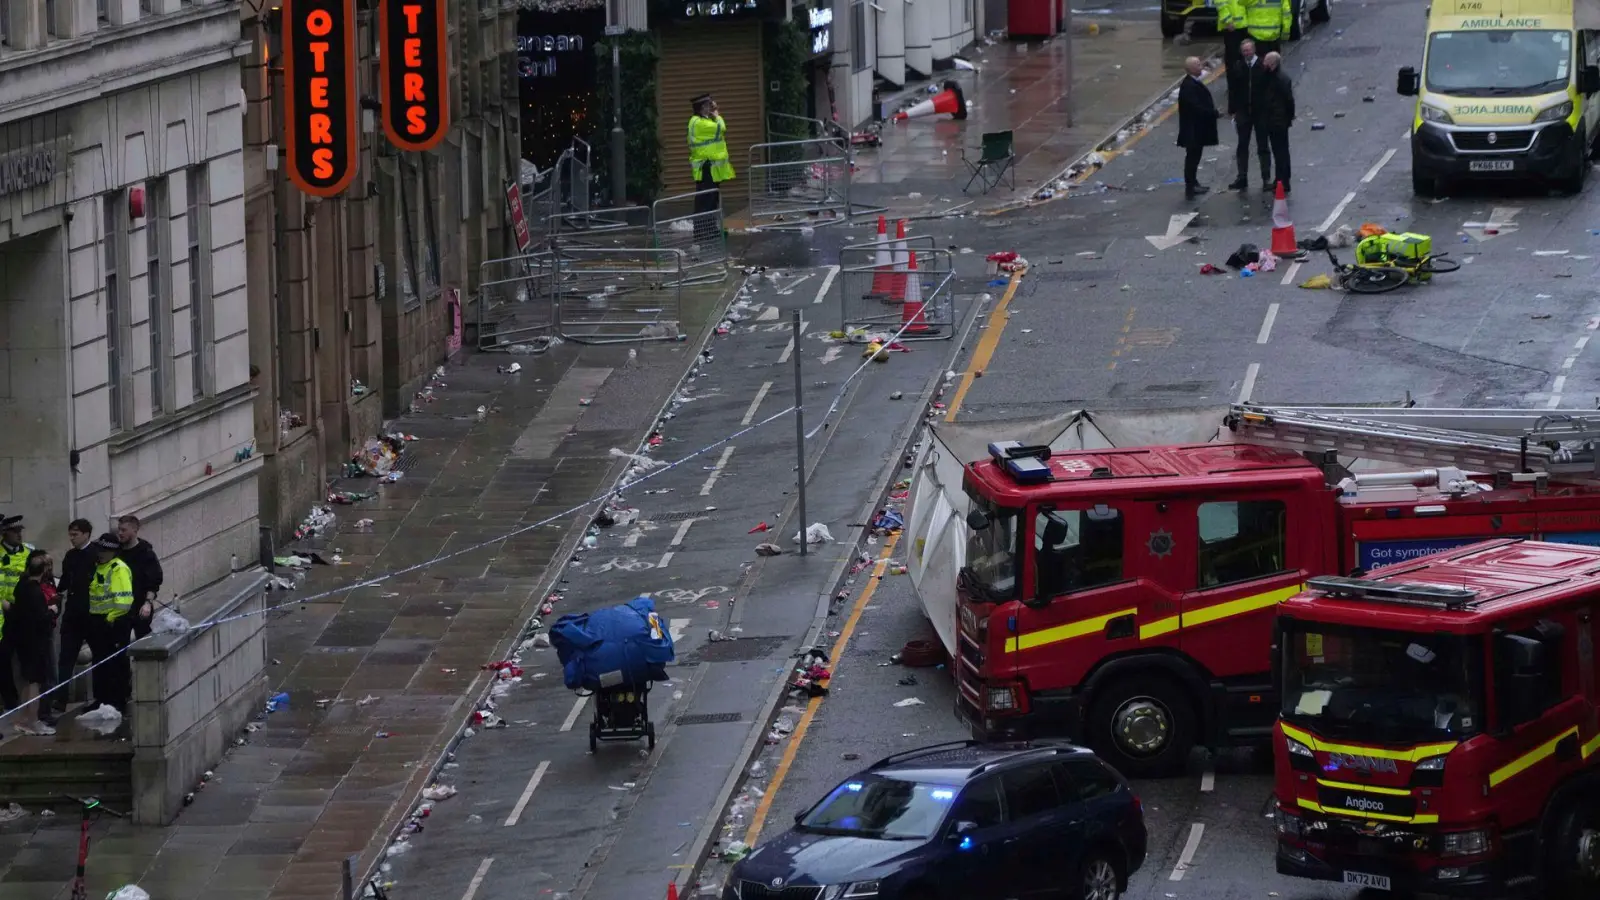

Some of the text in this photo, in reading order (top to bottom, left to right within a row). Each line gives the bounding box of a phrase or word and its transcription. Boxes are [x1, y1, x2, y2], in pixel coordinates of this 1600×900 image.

[1461, 19, 1541, 28] AMBULANCE
[402, 5, 427, 135] TERS
[306, 9, 334, 179] OTERS
[1371, 544, 1463, 559] Got symptom
[1346, 796, 1384, 811] Angloco
[1347, 873, 1387, 888] DK72 AVU
